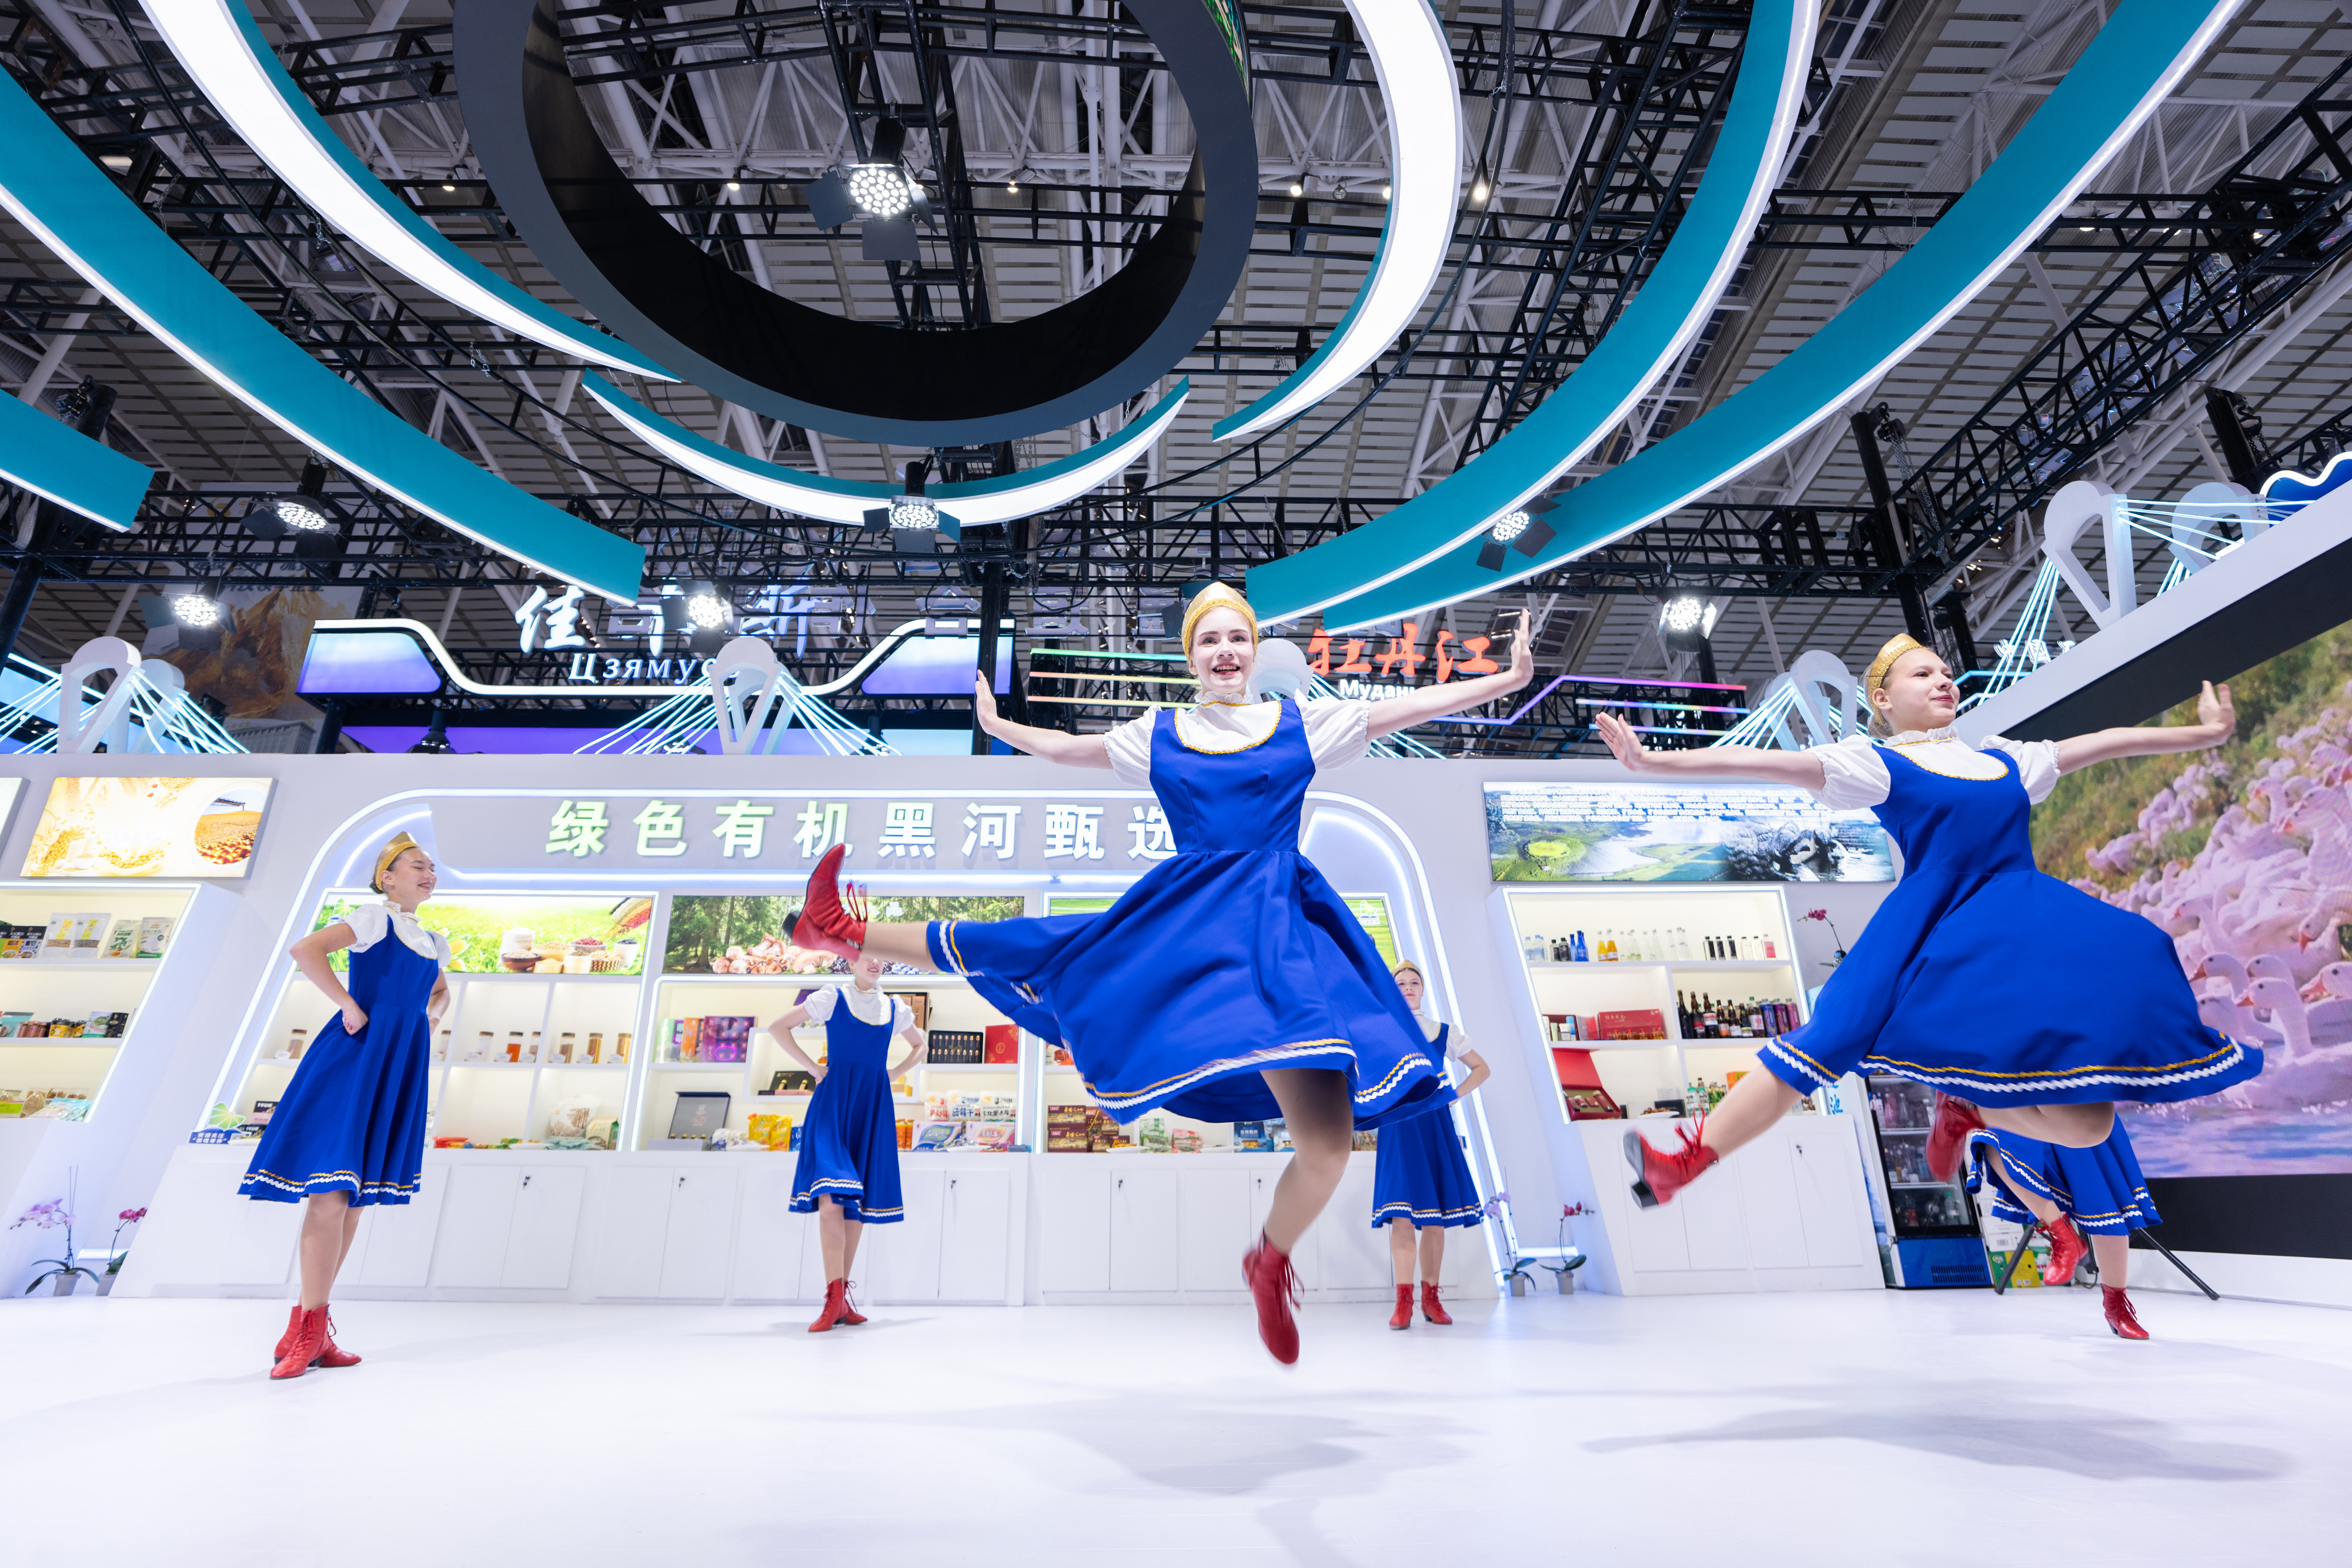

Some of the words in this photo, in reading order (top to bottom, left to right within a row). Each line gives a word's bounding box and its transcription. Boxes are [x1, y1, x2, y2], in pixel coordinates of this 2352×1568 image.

[568, 653, 740, 684] Цзямус
[1307, 623, 1499, 684] 牡丹江
[546, 800, 1178, 861] 绿色有机黑河甄选
